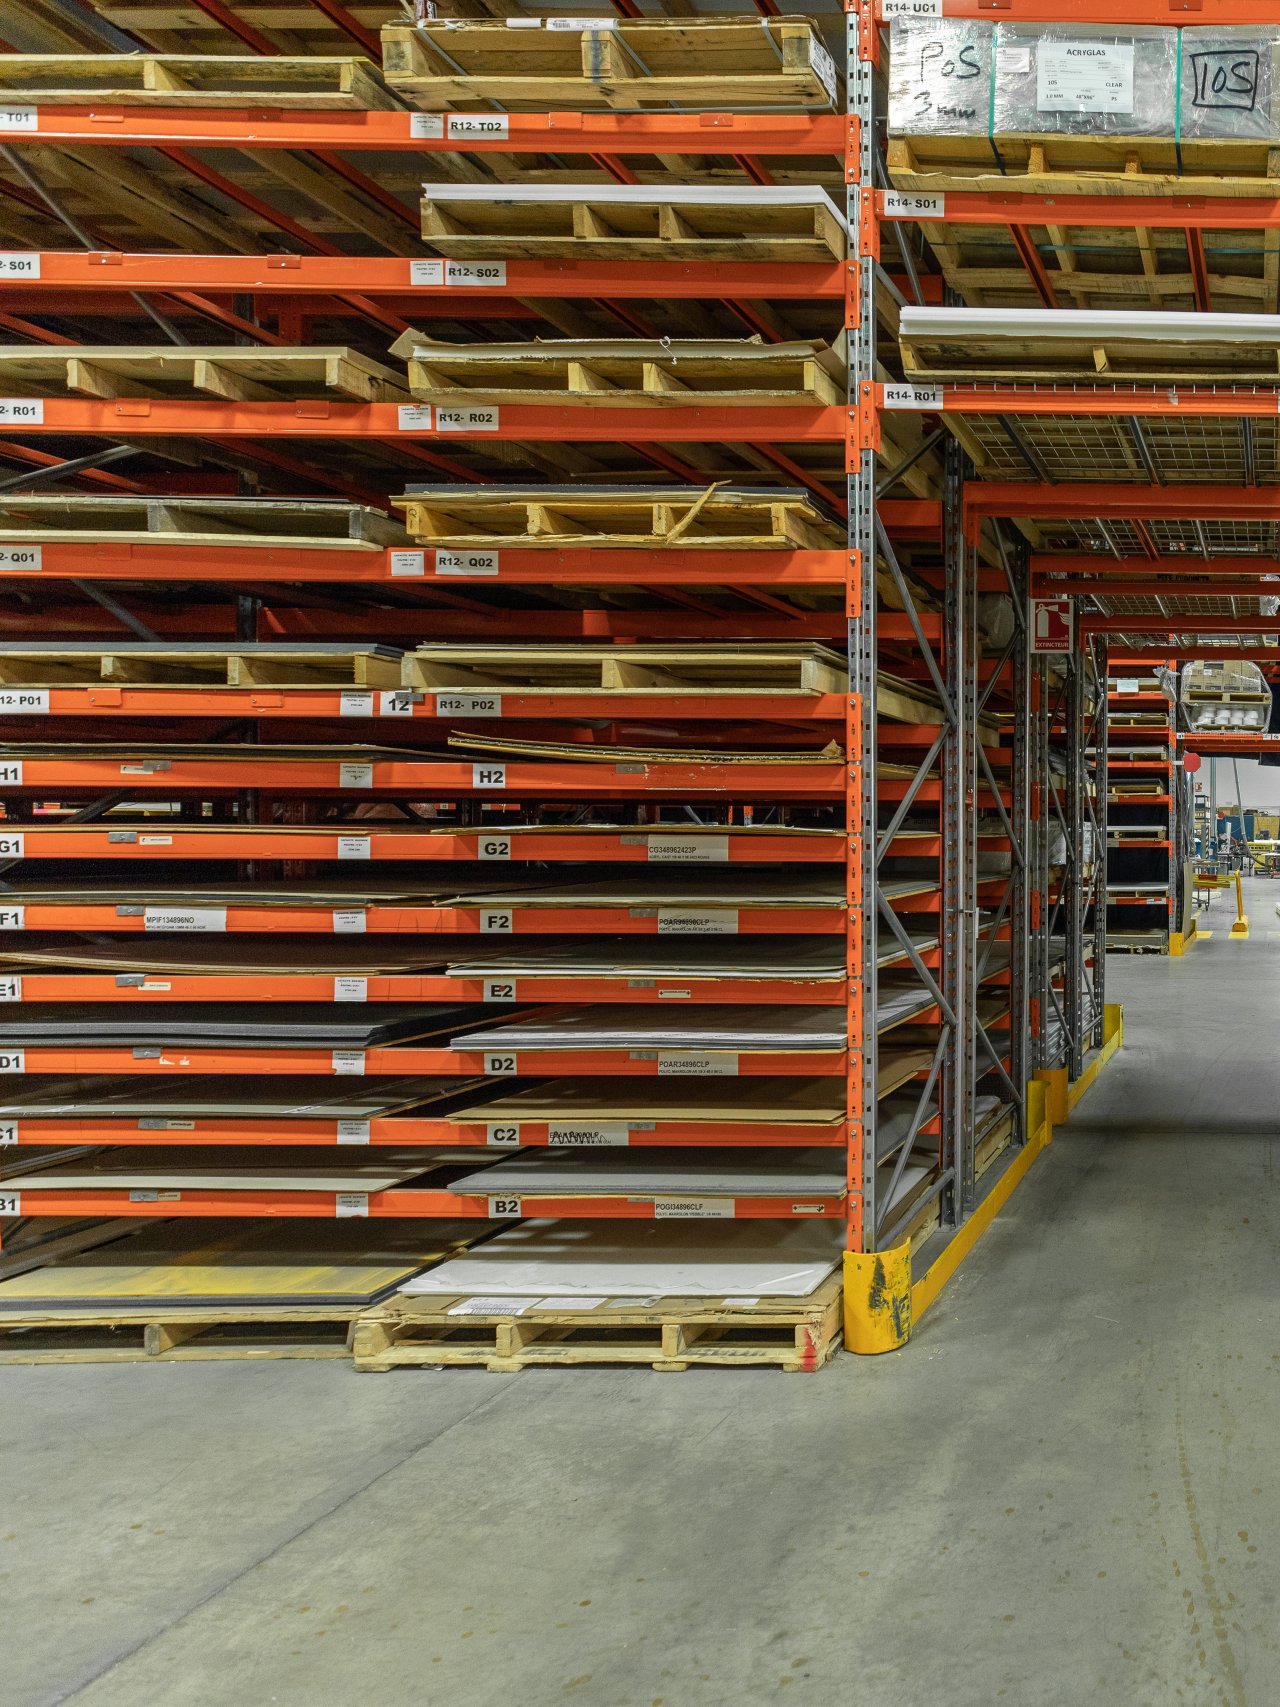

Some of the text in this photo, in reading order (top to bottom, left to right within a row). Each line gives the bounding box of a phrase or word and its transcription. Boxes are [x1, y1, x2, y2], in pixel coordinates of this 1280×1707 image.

[886, 3, 935, 12] R14- U01
[1066, 48, 1106, 56] ACRYGLAS
[6, 112, 29, 122] T01
[451, 122, 476, 130] R12-
[478, 122, 502, 132] T02
[888, 198, 936, 208] R14- S01
[10, 261, 31, 270] S01
[449, 268, 474, 276] R12-
[476, 269, 499, 278] S02
[887, 391, 936, 401] R14- R01
[13, 407, 35, 416] R01
[440, 414, 492, 422] R12- R02
[11, 553, 34, 562] Q01
[439, 557, 493, 567] R12- Q02
[20, 696, 40, 705] P01
[388, 698, 409, 711] 12
[440, 700, 494, 710] R12- P02
[480, 771, 503, 783] H2
[0, 840, 20, 853] G1
[485, 842, 508, 855] G2
[0, 913, 18, 925] F1
[488, 916, 509, 928] F2
[491, 985, 512, 998] E2
[0, 1056, 20, 1068] D1
[491, 1058, 514, 1071] D2
[494, 1128, 516, 1141] C2
[496, 1200, 518, 1213] B2
